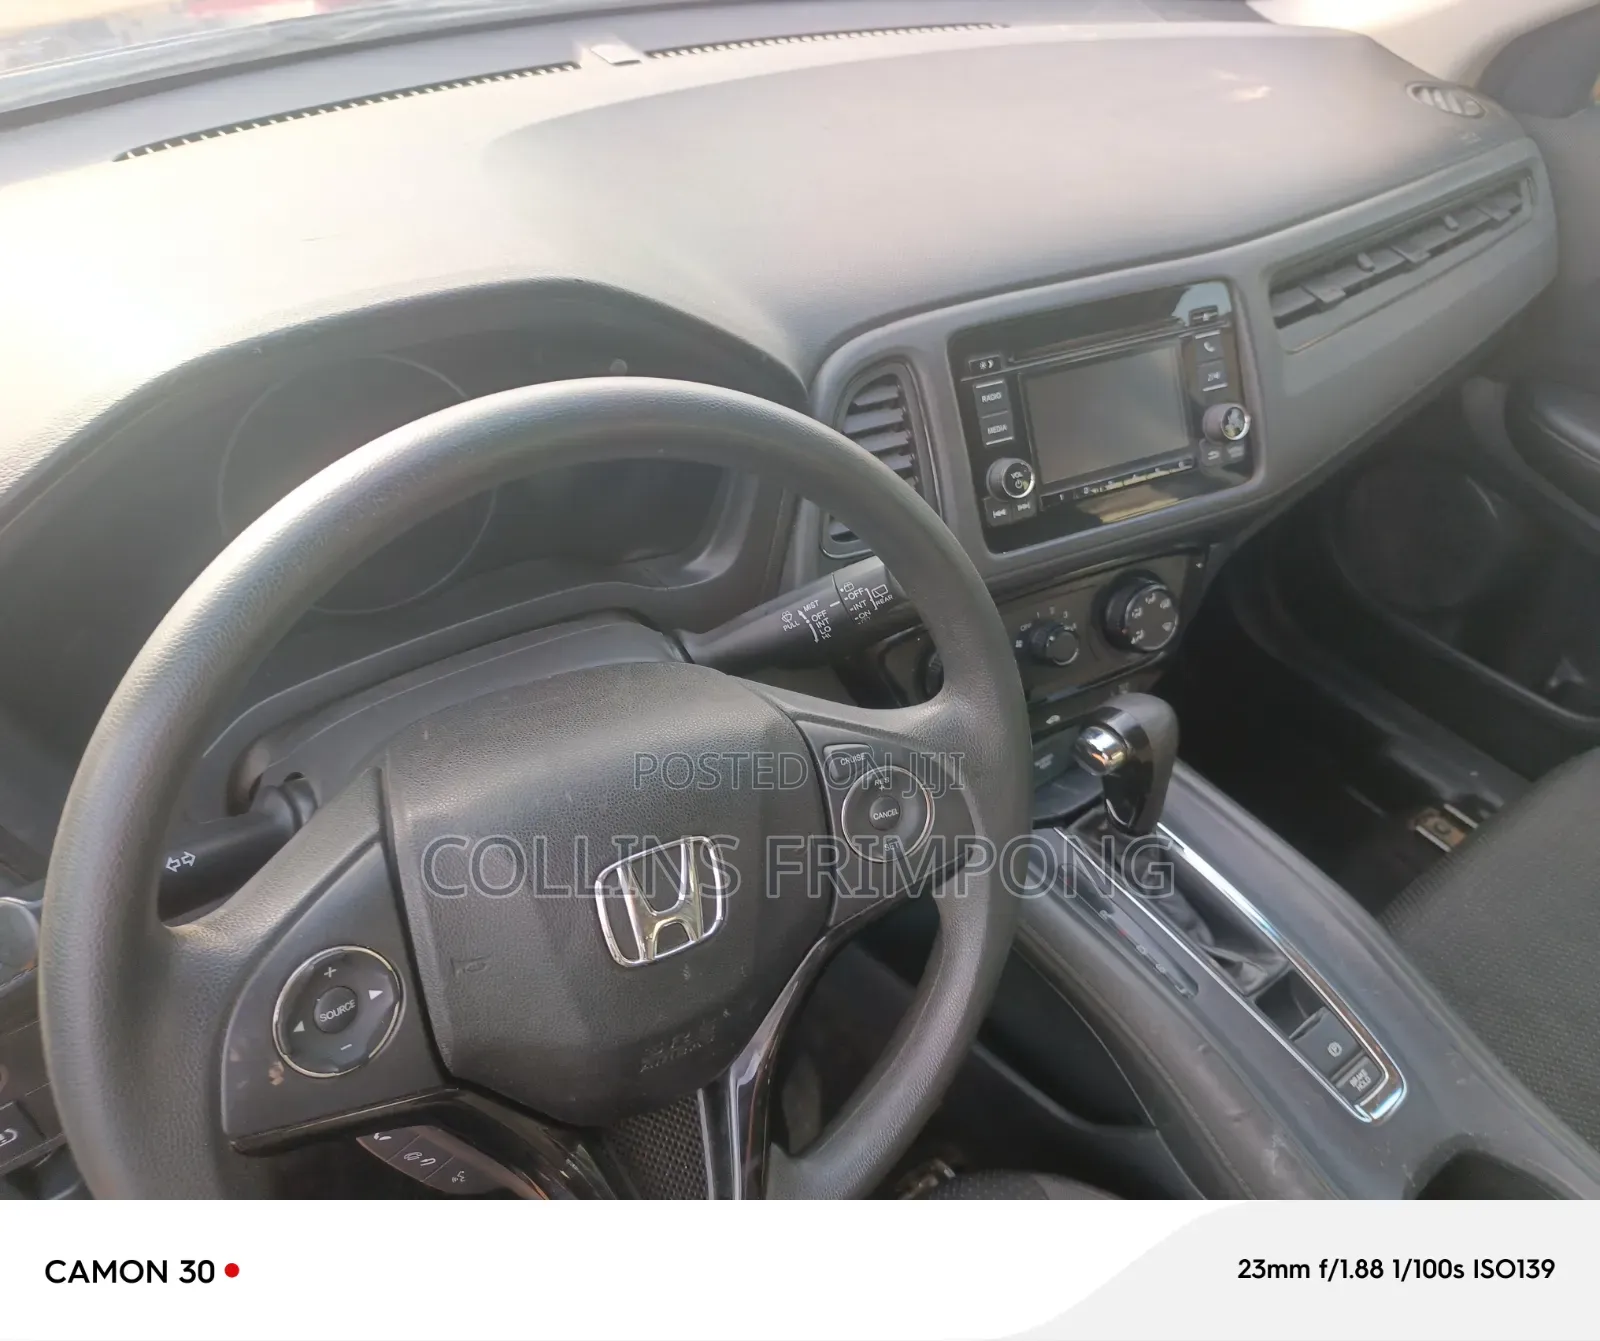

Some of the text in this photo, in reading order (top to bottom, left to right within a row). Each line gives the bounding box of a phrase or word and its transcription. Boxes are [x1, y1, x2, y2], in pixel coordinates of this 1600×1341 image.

[981, 392, 1002, 403] RADIO
[987, 424, 1008, 435] MEDIA
[1011, 471, 1023, 479] VOL
[848, 587, 864, 600] OFF
[803, 600, 820, 613] MIST
[853, 600, 867, 612] INT
[875, 594, 893, 608] REAR
[811, 609, 828, 622] OFF
[858, 610, 872, 620] ON
[783, 620, 801, 632] PULL
[816, 617, 830, 629] INT
[820, 625, 832, 635] LO
[840, 753, 867, 767] CRUISE
[873, 808, 899, 820] CANCEL
[320, 999, 356, 1022] SOURCE
